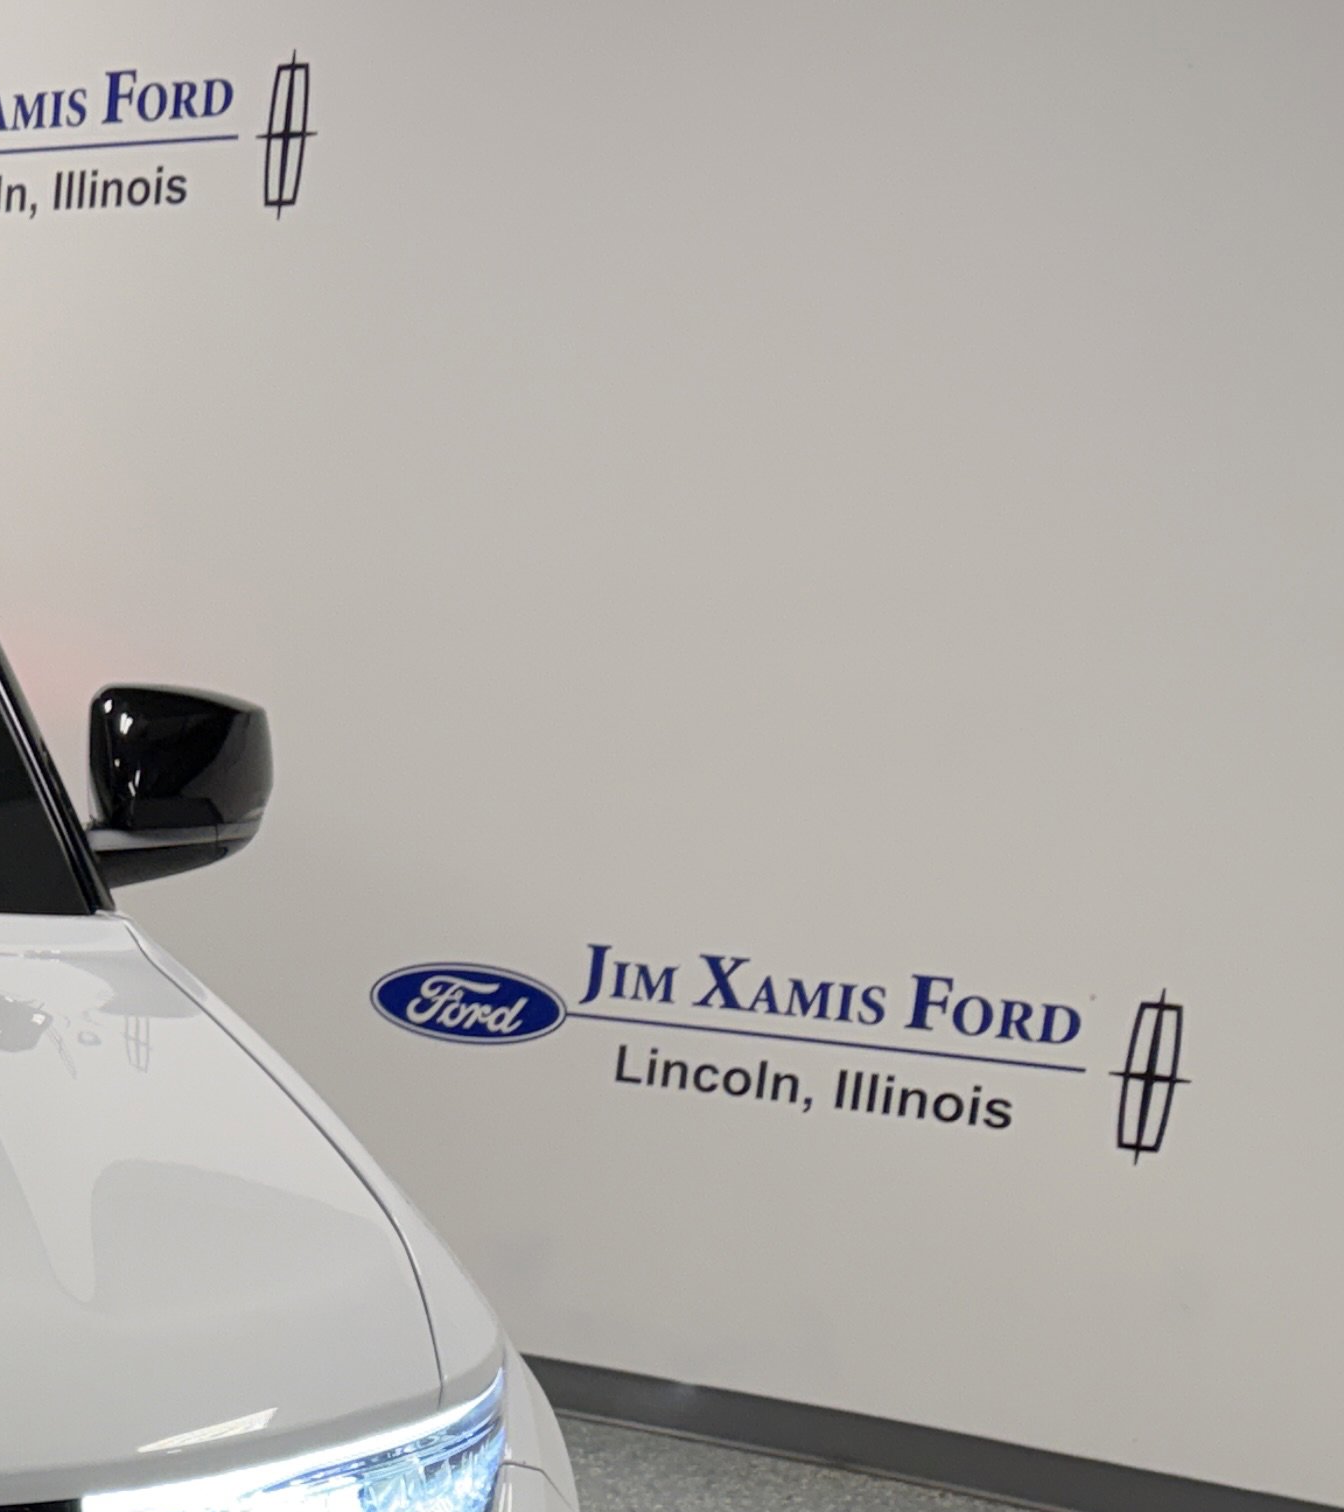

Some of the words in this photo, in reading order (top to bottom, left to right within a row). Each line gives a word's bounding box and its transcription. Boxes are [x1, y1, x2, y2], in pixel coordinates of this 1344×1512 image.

[102, 69, 234, 125] FORD
[52, 165, 188, 211] Illinois
[406, 973, 523, 1036] Ford
[580, 944, 680, 1005] JIM
[693, 954, 888, 1027] XAMIS
[905, 974, 1082, 1046] FORD
[615, 1045, 812, 1113] Lincoln,
[834, 1070, 1014, 1130] Illinois
